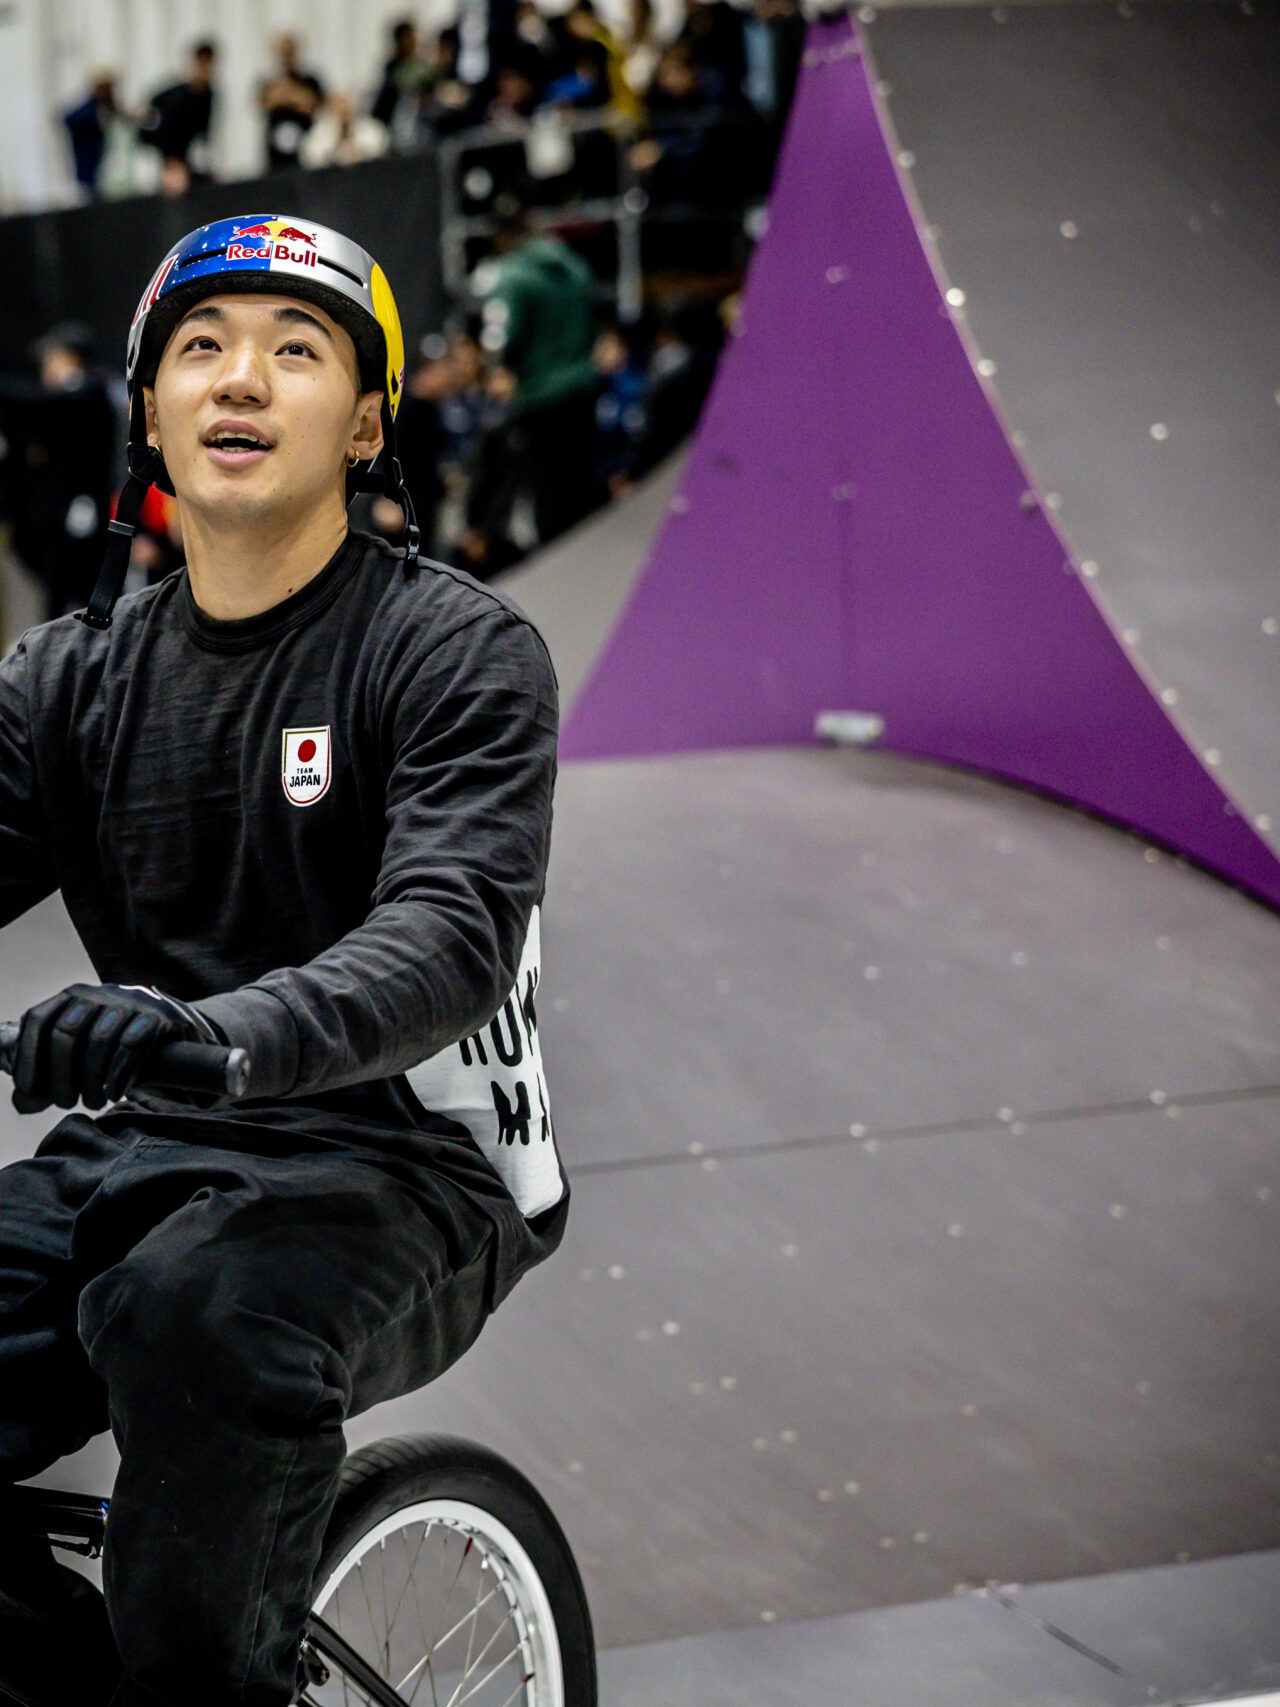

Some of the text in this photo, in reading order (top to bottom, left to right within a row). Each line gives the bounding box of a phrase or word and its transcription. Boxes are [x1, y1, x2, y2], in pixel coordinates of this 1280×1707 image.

[227, 243, 317, 267] Red Bull
[296, 767, 314, 775] TEAM
[289, 774, 321, 788] JAPAN
